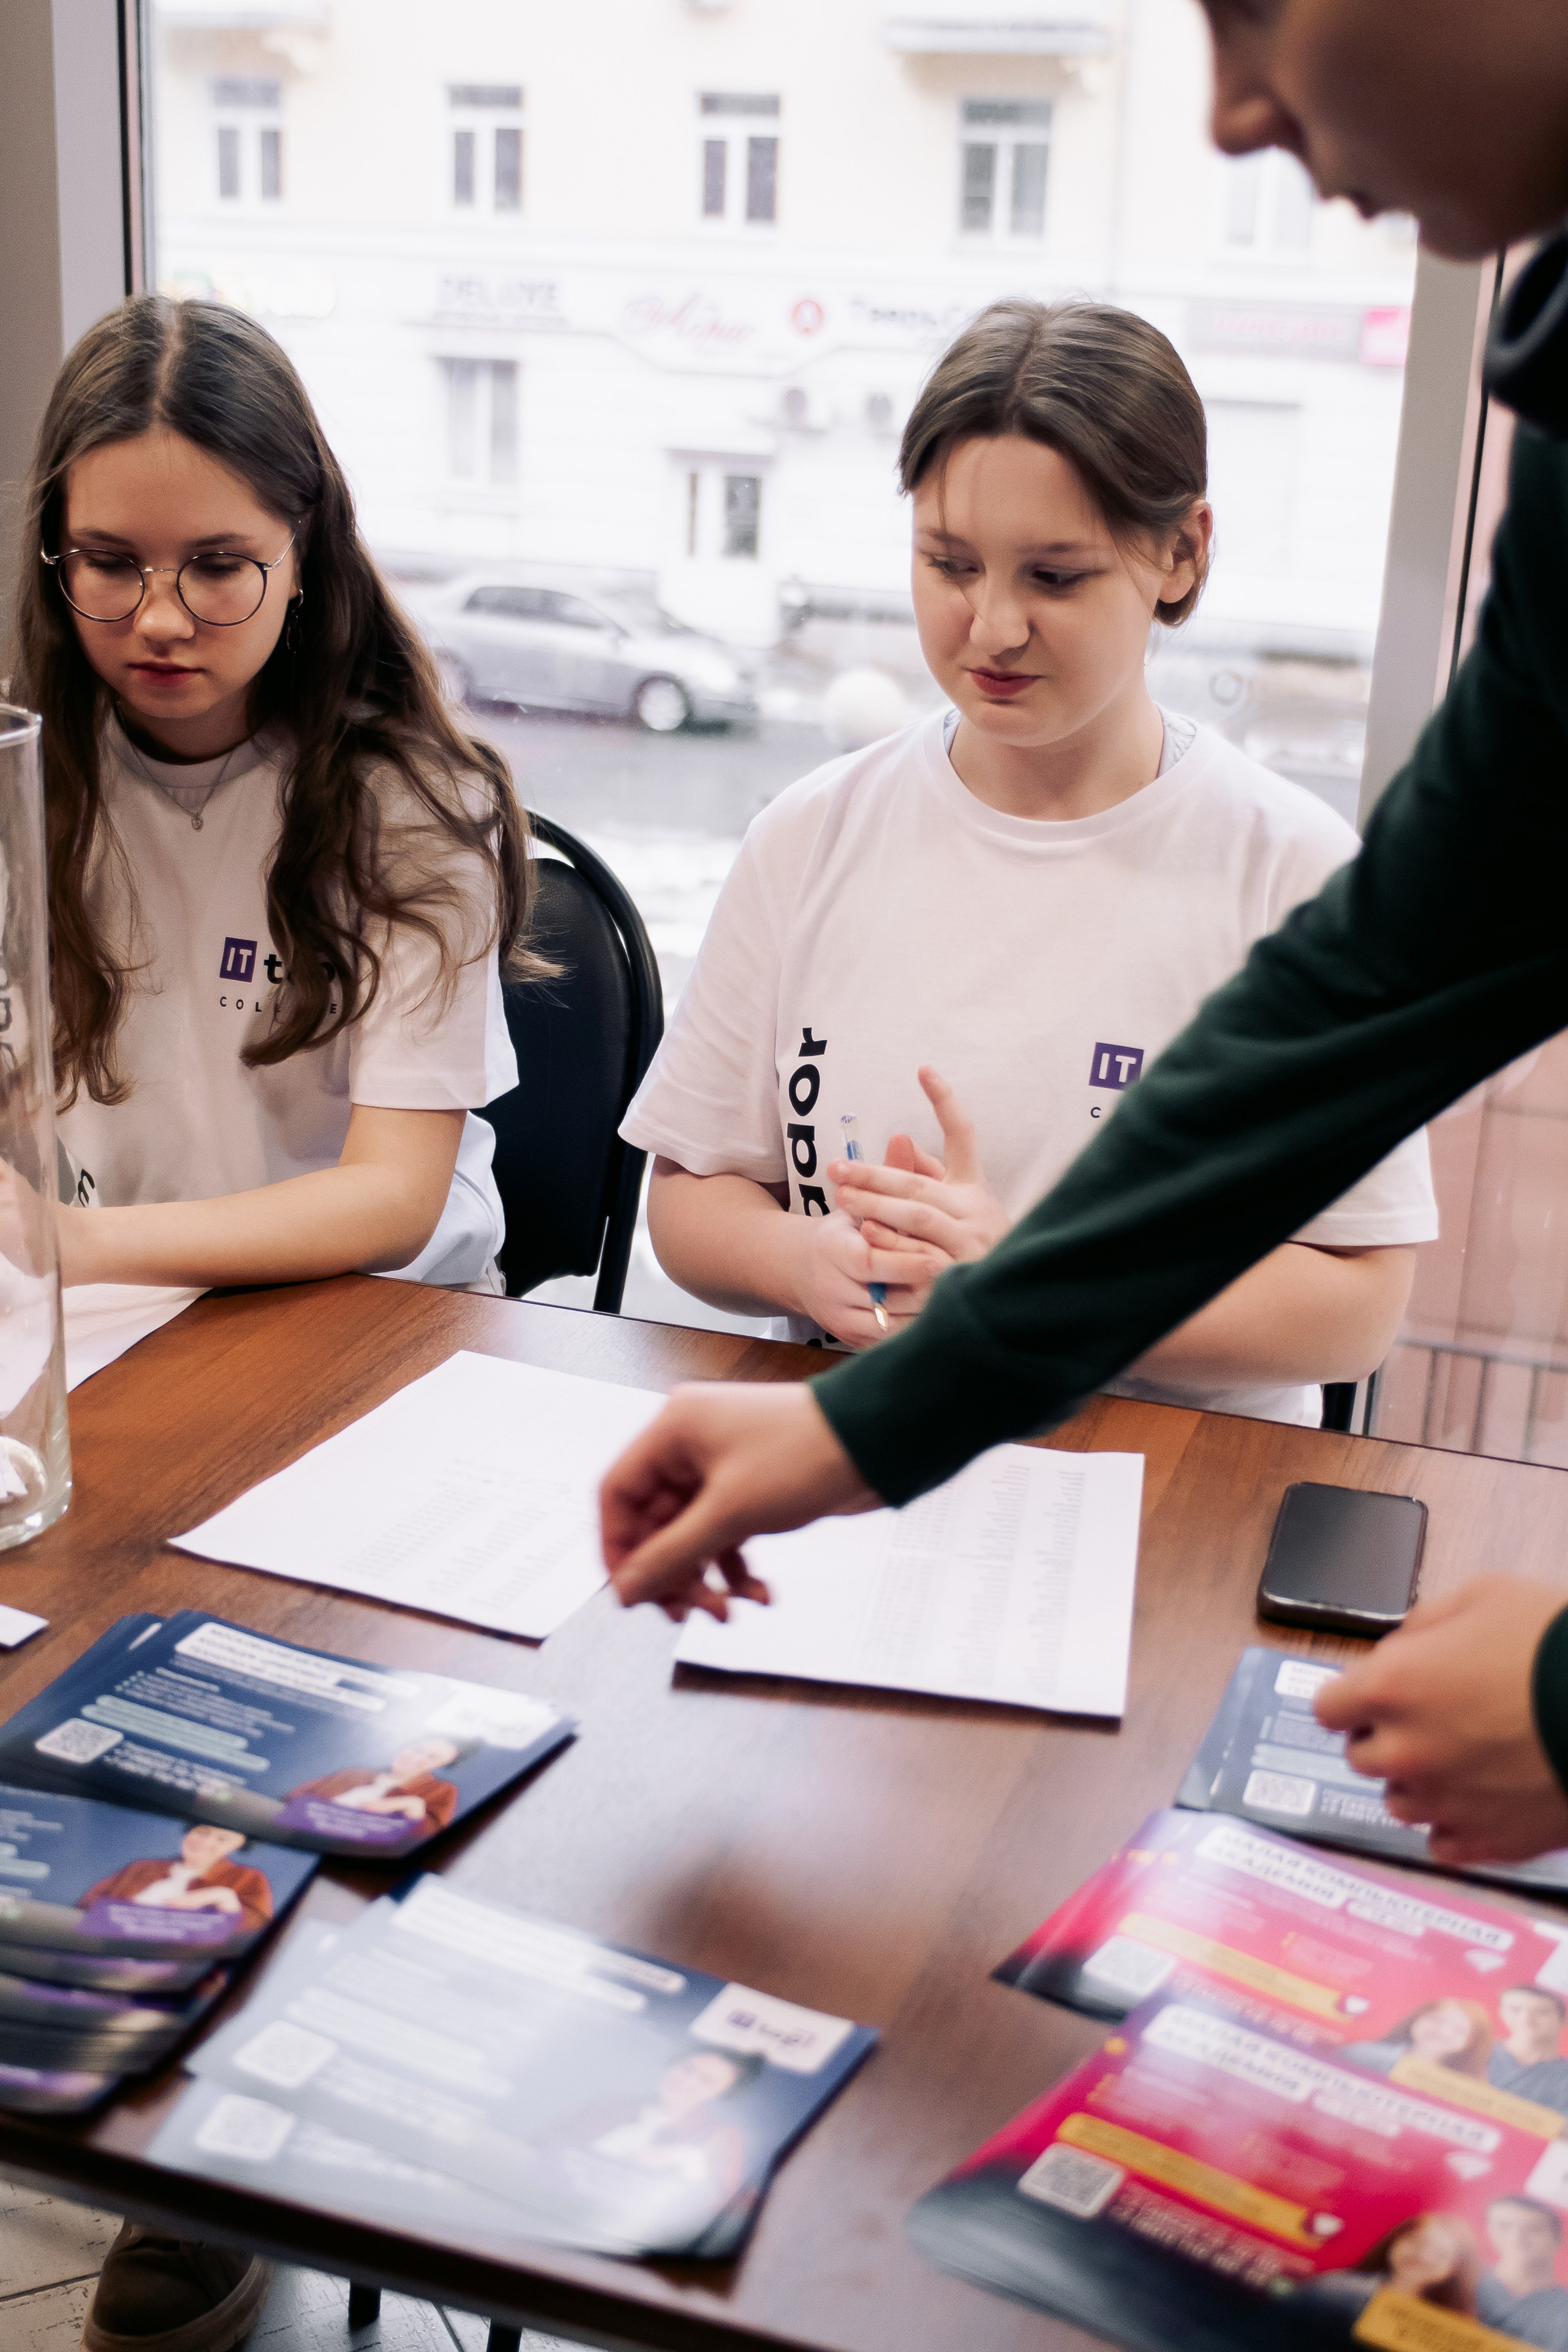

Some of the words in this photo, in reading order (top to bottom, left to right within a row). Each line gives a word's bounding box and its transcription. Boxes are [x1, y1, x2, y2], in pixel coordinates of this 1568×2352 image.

[226, 947, 252, 974] IT
[219, 996, 337, 1014] COLLE
[1098, 1052, 1137, 1083] IT
